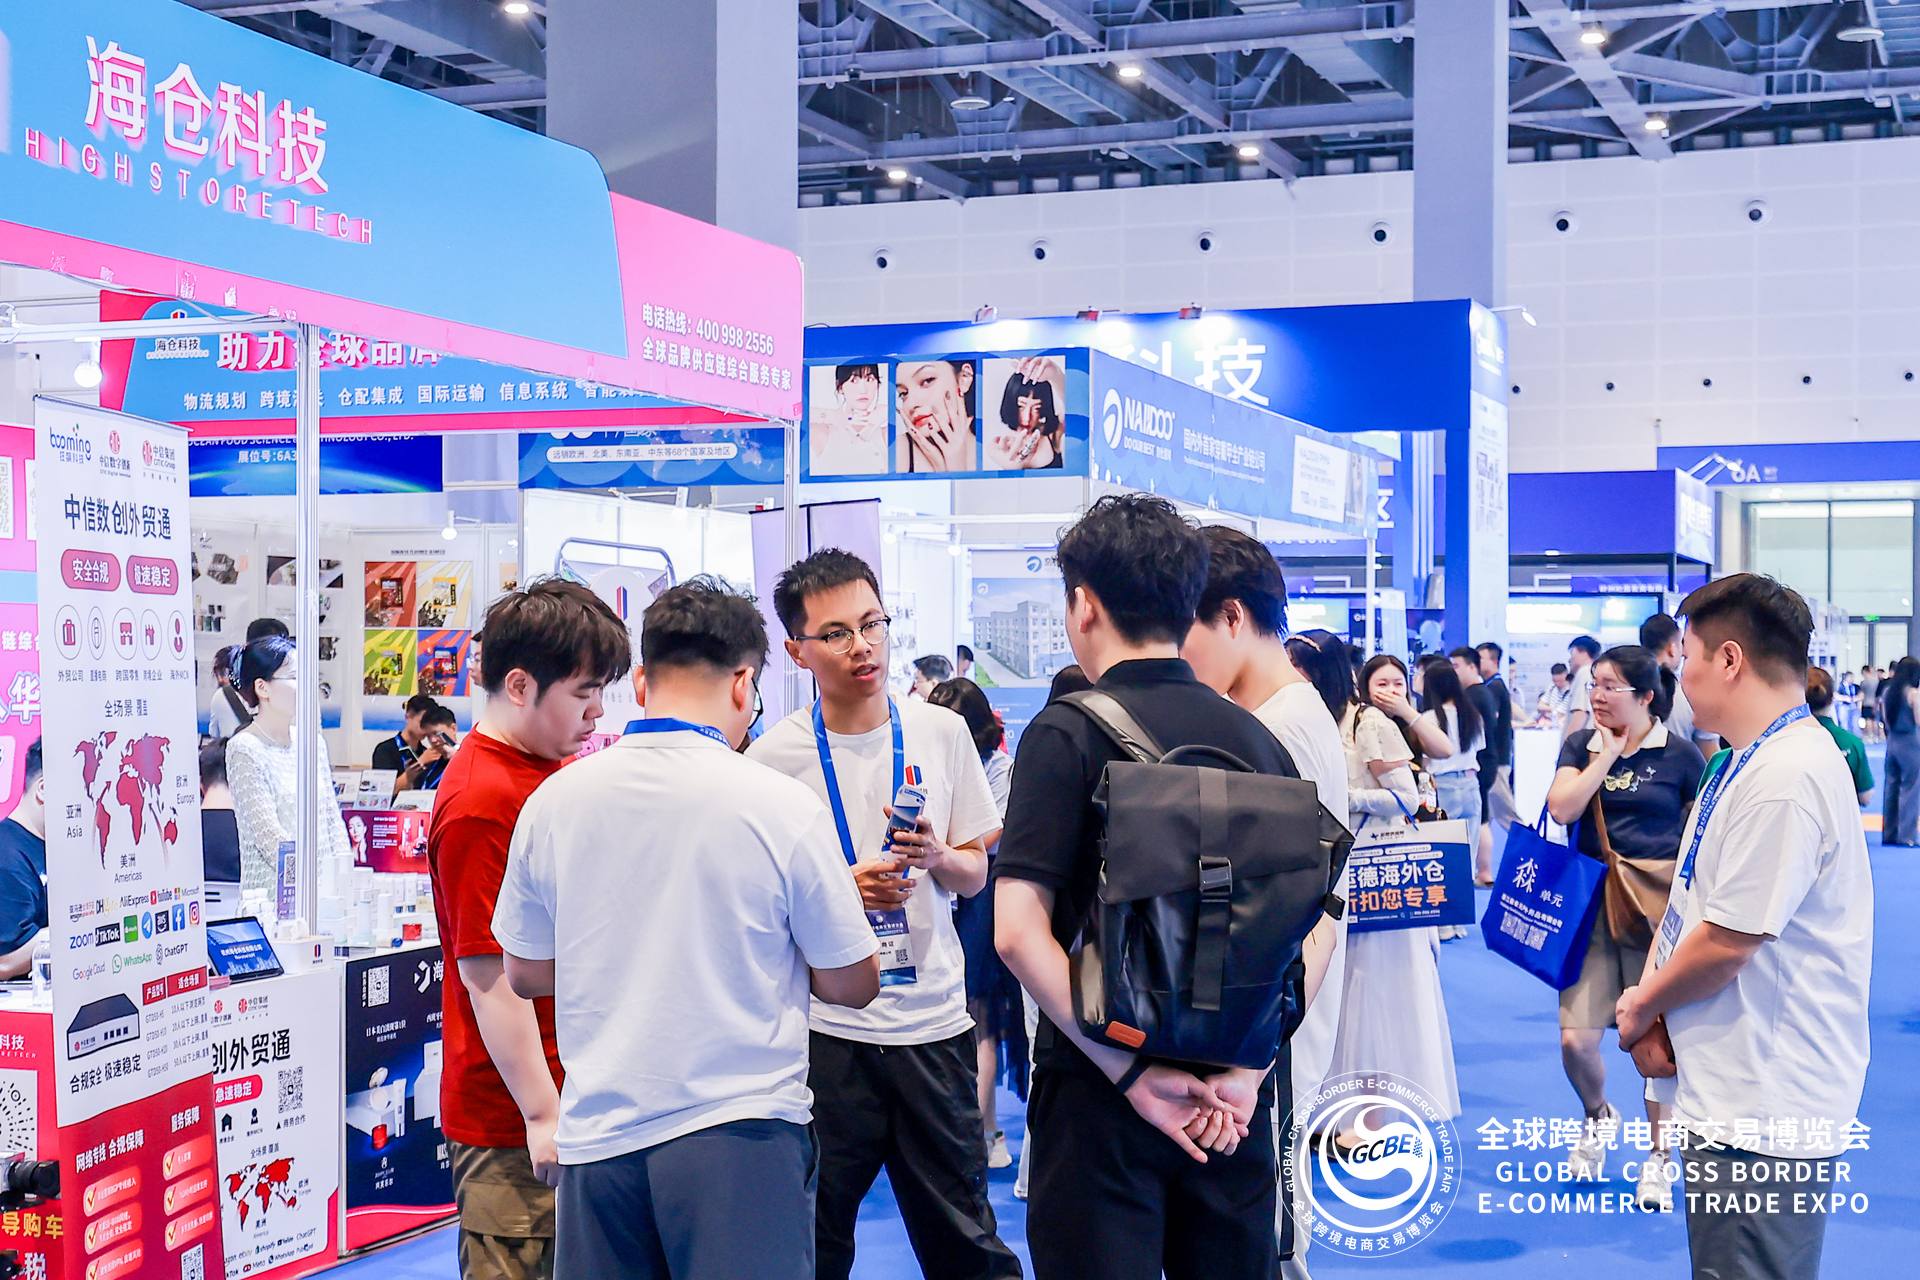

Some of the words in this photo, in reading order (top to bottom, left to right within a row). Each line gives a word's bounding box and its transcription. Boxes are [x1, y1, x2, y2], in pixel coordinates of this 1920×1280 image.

[84, 34, 330, 193] 海仓科技
[156, 338, 200, 351] 海仓科技
[696, 318, 720, 342] 400
[721, 324, 744, 349] 998
[745, 331, 774, 356] 2556
[642, 336, 792, 390] 全球品牌供应链综合服务专家
[184, 391, 246, 410] 物流规划
[260, 388, 324, 408] 跨境
[338, 386, 404, 405] 仓配集成
[417, 384, 486, 403] 国际运输
[499, 381, 568, 400] 信息系统
[50, 424, 91, 460] booming
[64, 493, 171, 540] 中信数创外贸通
[72, 558, 109, 583] 安全合规
[104, 700, 133, 718] 全场景
[66, 804, 82, 819] 亚洲
[67, 825, 83, 838] Asia
[120, 854, 136, 869] 美洲
[114, 872, 142, 884] Americas
[1540, 889, 1564, 908] 单元
[70, 932, 94, 949] zoom
[97, 928, 120, 945] TikTok
[123, 953, 152, 967] WhatsApp
[164, 943, 188, 958] ChatGPT
[70, 1067, 102, 1094] 合规安全
[104, 1054, 142, 1081] 极速稳定
[171, 1105, 200, 1133] 服务保障
[76, 1142, 107, 1174] 网络专线
[108, 1129, 145, 1158] 合规保障
[1, 1211, 64, 1239] 导购车
